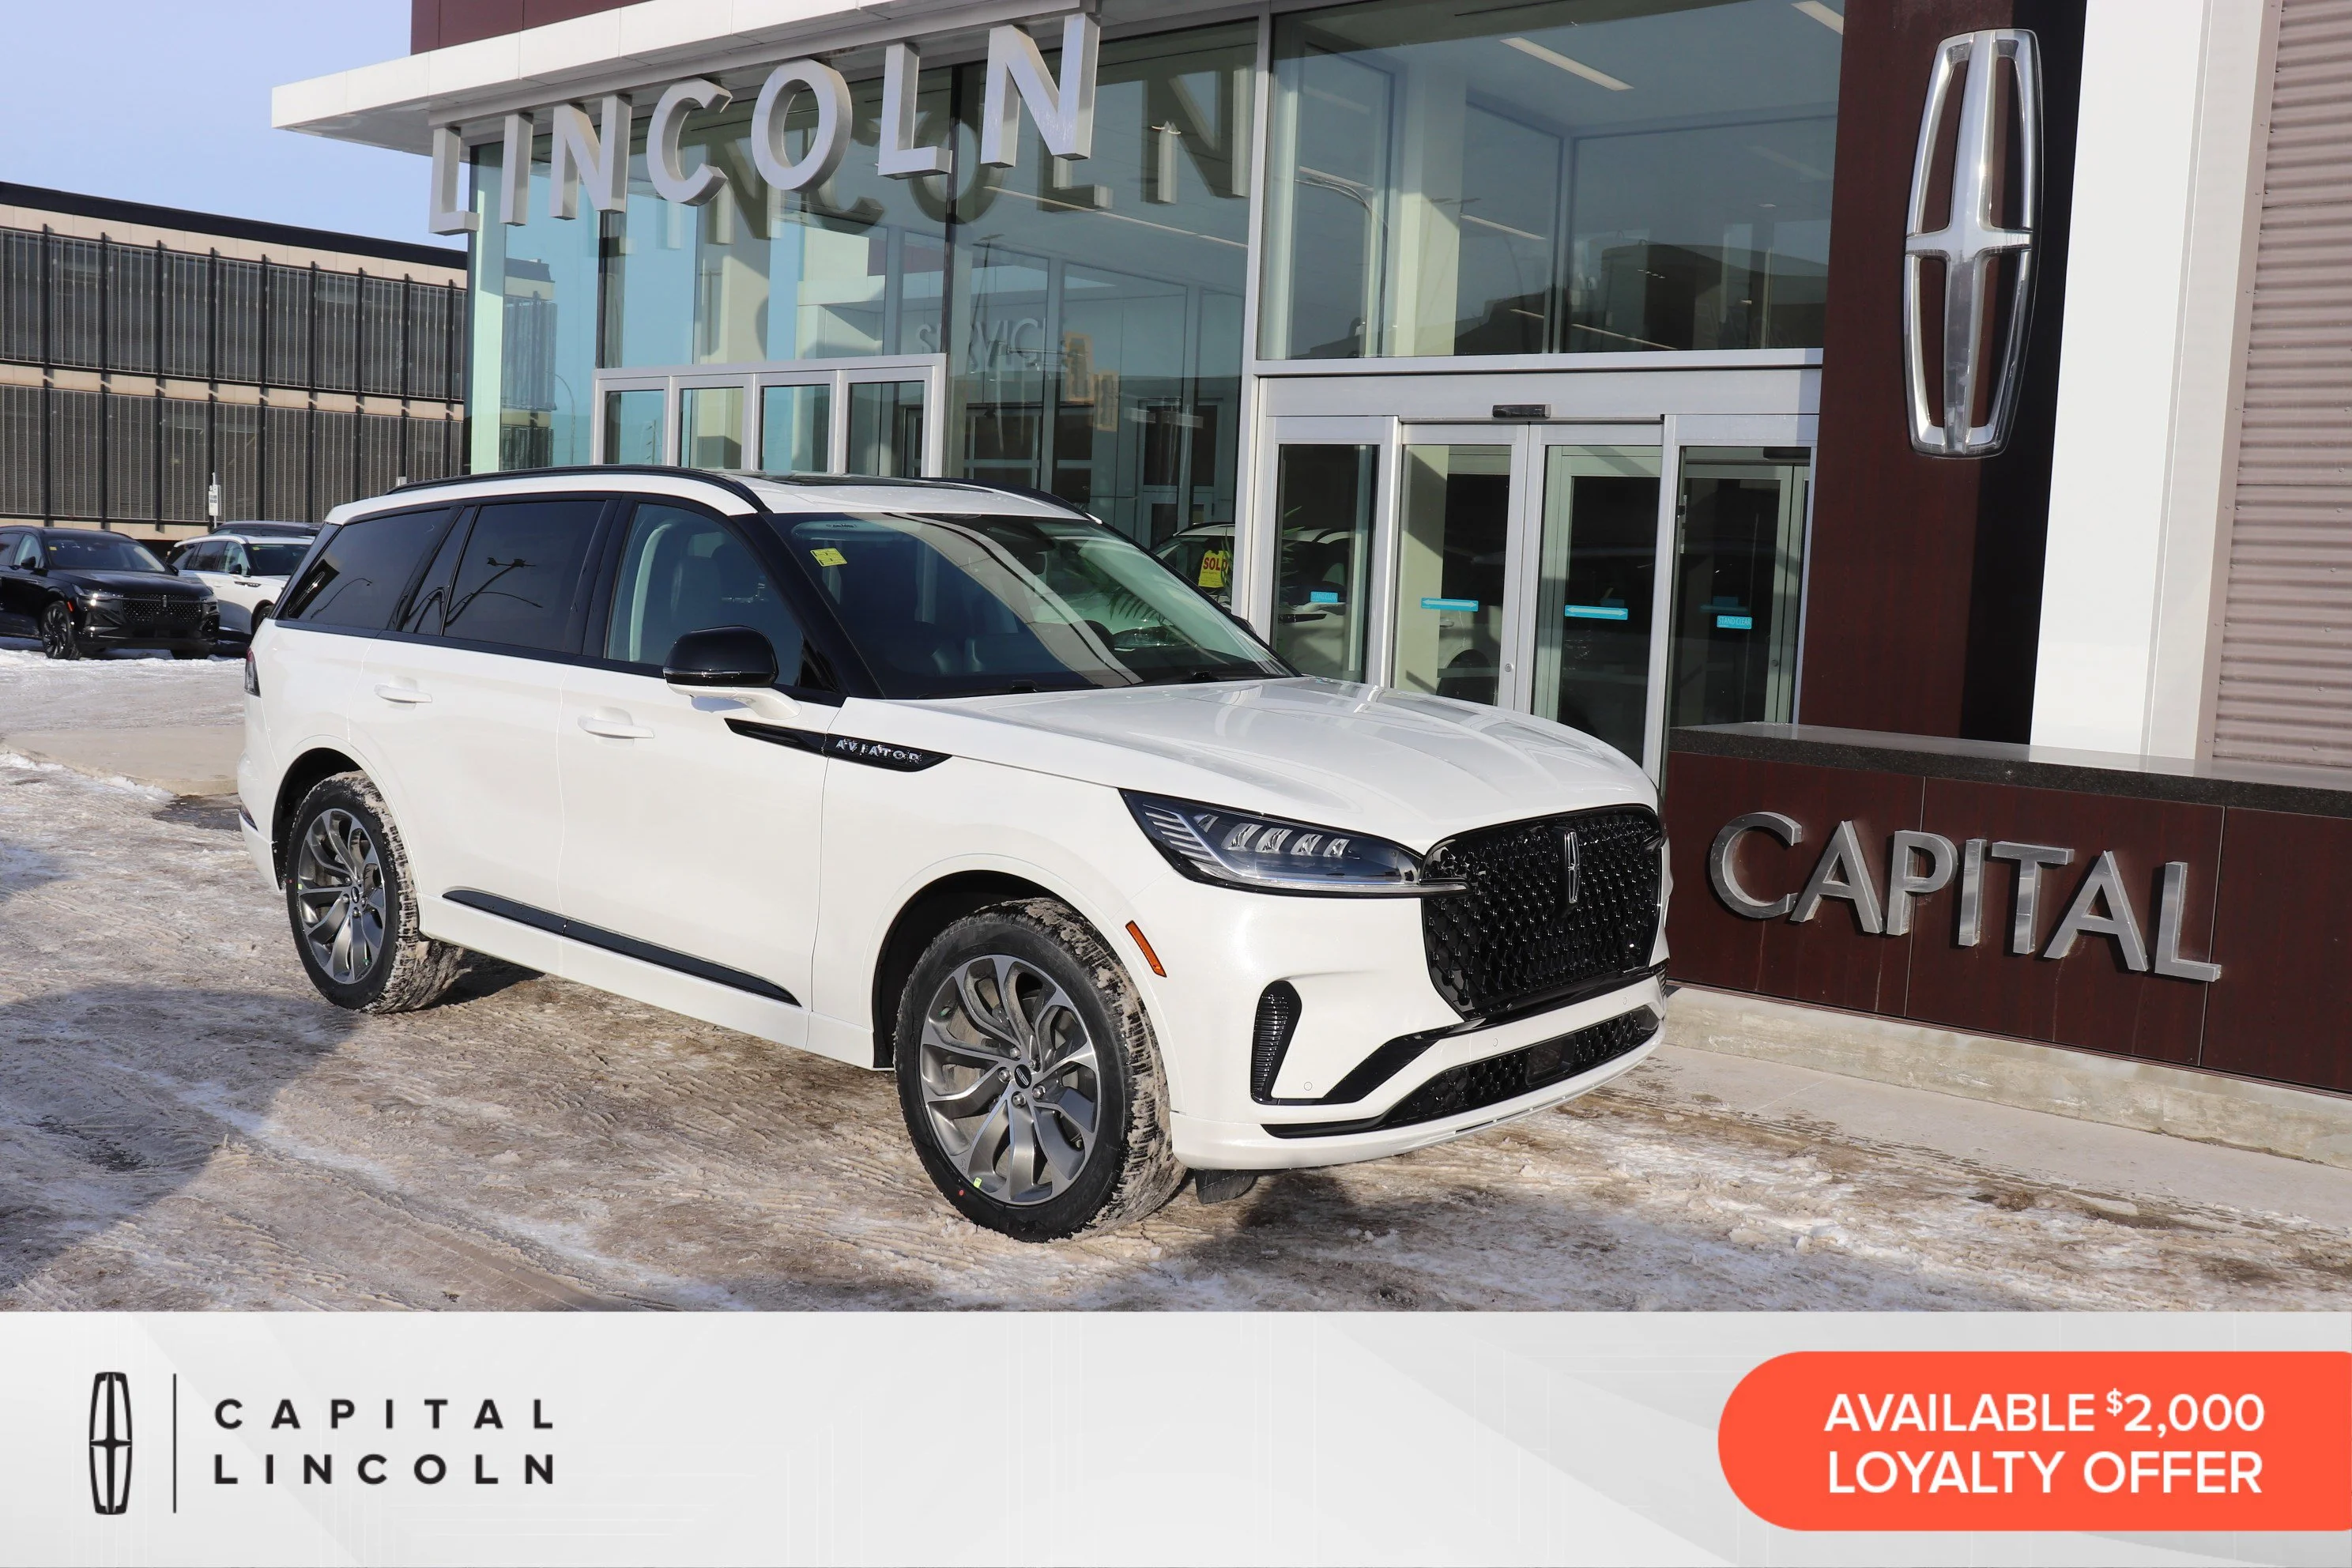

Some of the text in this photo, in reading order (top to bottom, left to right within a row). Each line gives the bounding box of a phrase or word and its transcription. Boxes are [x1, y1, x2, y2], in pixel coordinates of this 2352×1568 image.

[428, 13, 1101, 236] LINCOLN
[1203, 557, 1228, 571] SOLD
[835, 738, 922, 764] AVIATOR
[1709, 811, 2222, 982] CAPITAL
